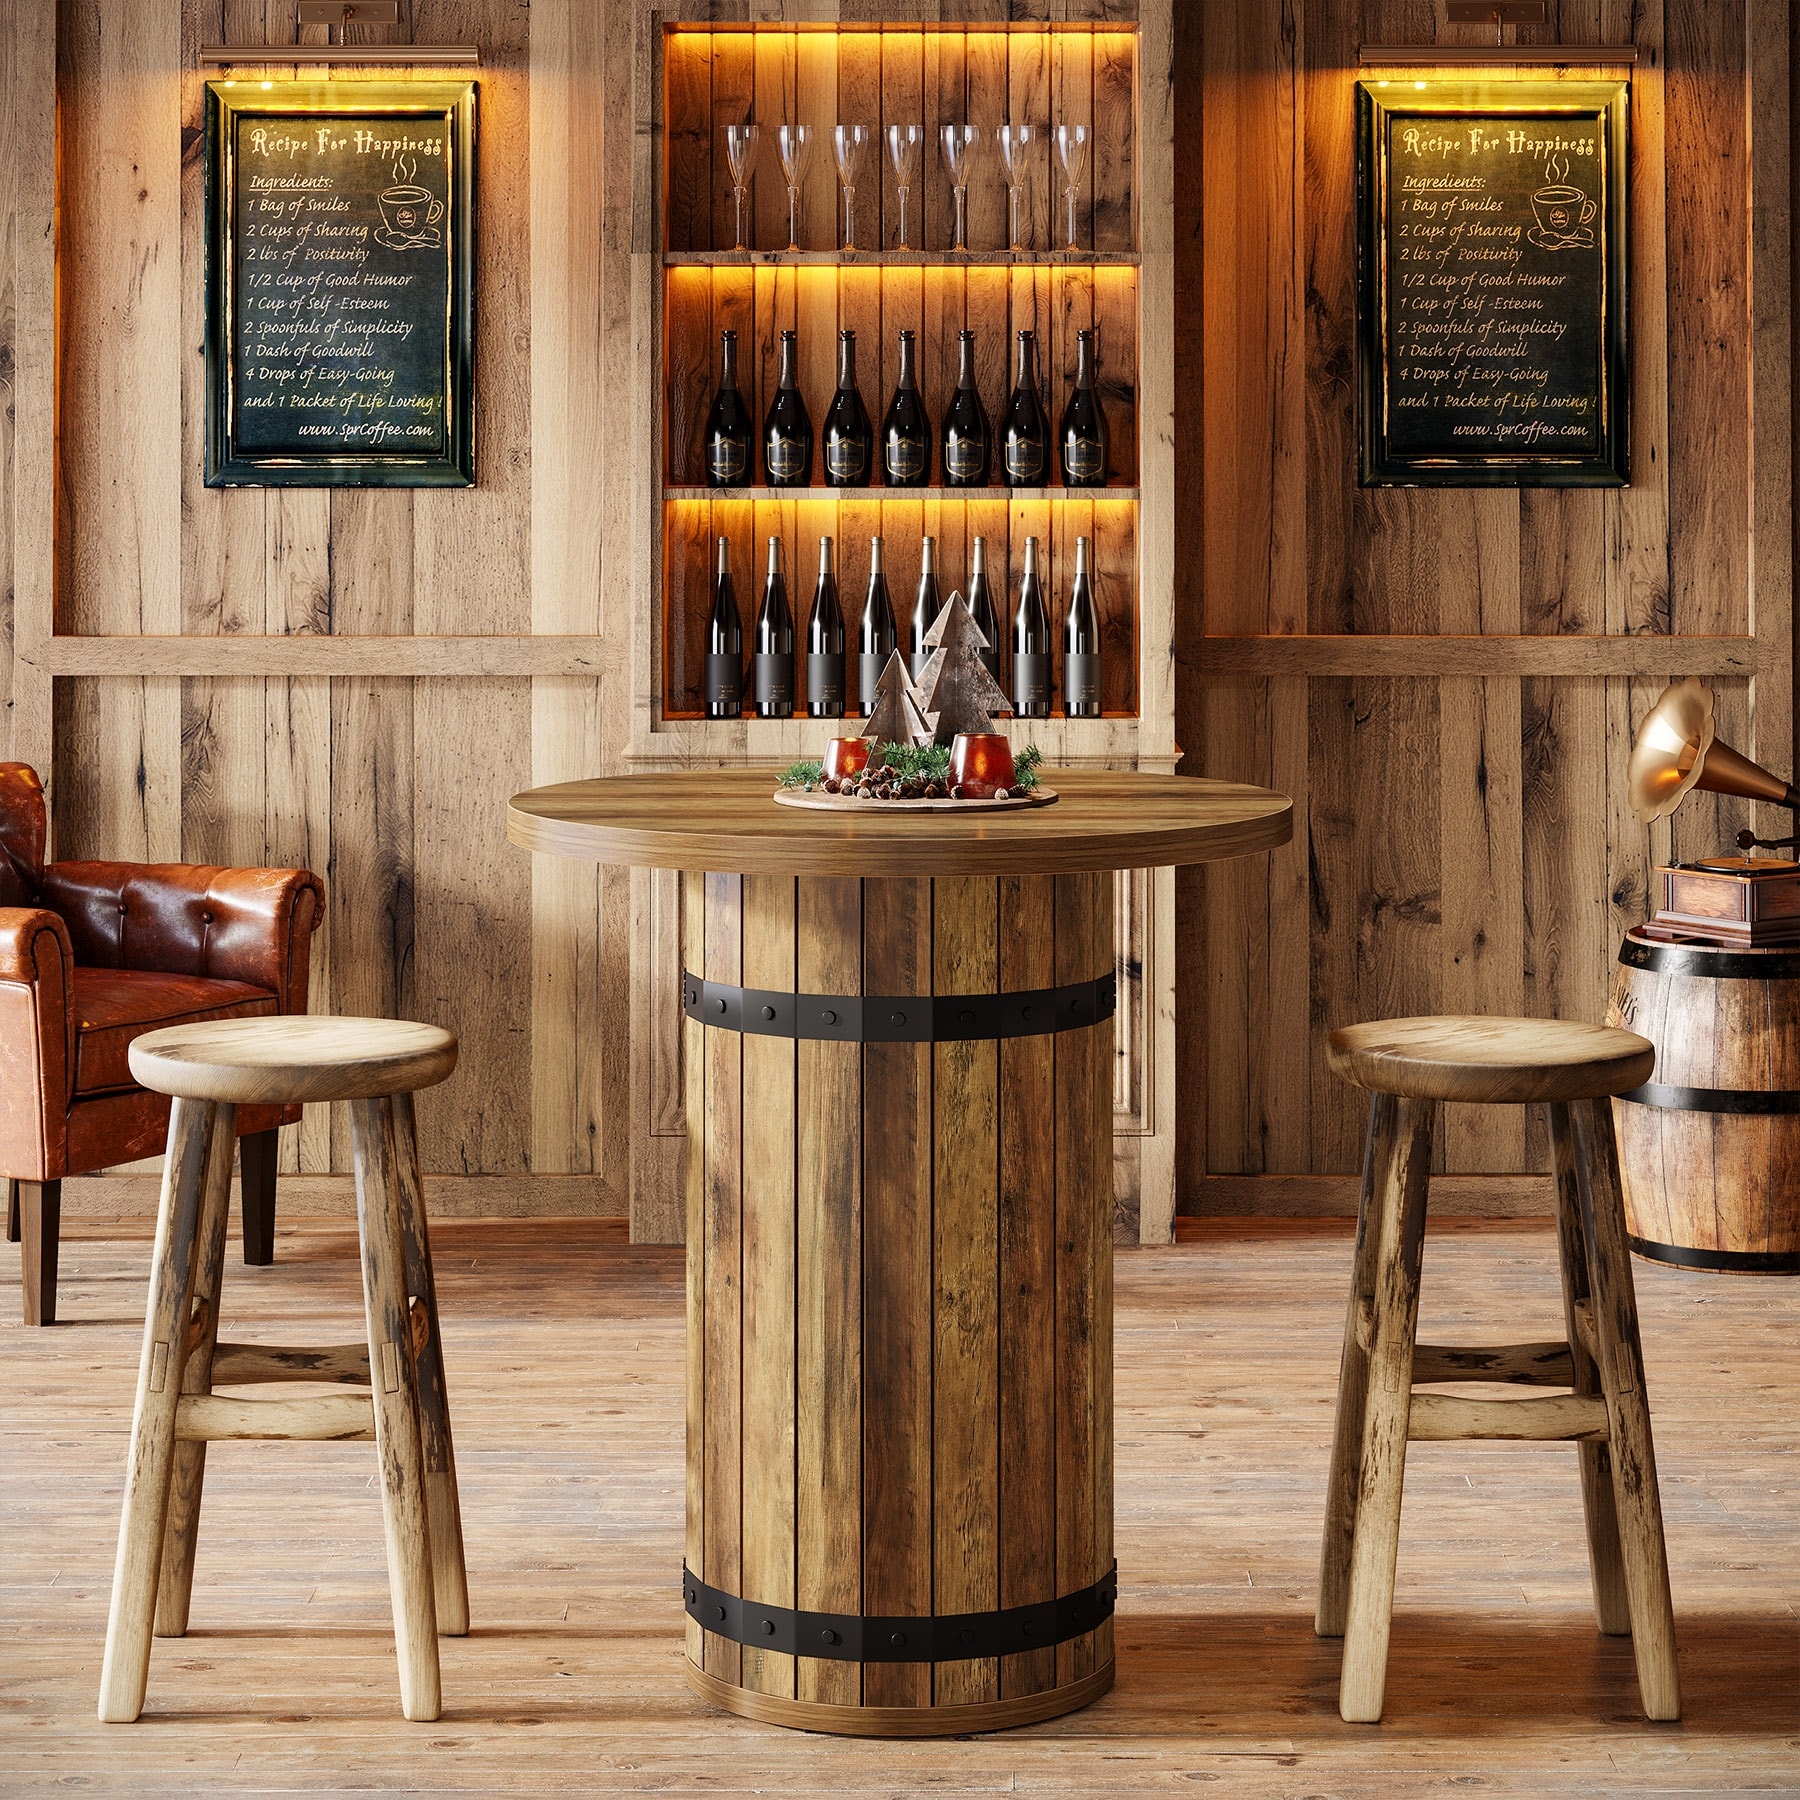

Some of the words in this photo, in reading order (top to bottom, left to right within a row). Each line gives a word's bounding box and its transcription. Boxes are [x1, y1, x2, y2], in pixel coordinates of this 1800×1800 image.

[250, 128, 308, 160] Recipe
[315, 127, 347, 155] For
[353, 130, 442, 160] Happiness
[1402, 128, 1461, 160] Recipe
[1467, 127, 1500, 155] For
[1505, 130, 1595, 160] Happiness
[250, 173, 333, 196] Ingredients:
[1402, 173, 1487, 196] Ingredients:
[248, 200, 255, 211] 1
[259, 199, 285, 219] Bag
[289, 196, 305, 220] of
[306, 196, 351, 212] Smiles
[1401, 200, 1408, 211] 1
[1412, 199, 1438, 219] Bag
[1441, 196, 1458, 220] of
[1460, 196, 1504, 212] Smiles
[246, 224, 255, 237] 2
[259, 224, 294, 243] Cups
[296, 221, 313, 245] of
[314, 221, 369, 244] Sharing
[1399, 224, 1409, 237] 2
[1412, 224, 1447, 243] Cups
[1449, 221, 1466, 245] of
[1467, 221, 1523, 244] Sharing
[246, 248, 256, 260] 2
[260, 245, 279, 261] lbs
[282, 245, 299, 269] of
[304, 247, 370, 268] Positivity
[1400, 248, 1410, 260] 2
[1413, 245, 1432, 261] lbs
[1435, 245, 1452, 269] of
[1457, 247, 1523, 268] Positivity
[248, 273, 272, 287] 1/2
[276, 273, 306, 292] Cup
[307, 271, 324, 294] of
[325, 271, 361, 287] Good
[363, 273, 413, 286] Humor
[1402, 273, 1426, 287] 1/2
[1429, 273, 1460, 292] Cup
[1460, 271, 1477, 295] of
[1478, 271, 1514, 287] Good
[1517, 273, 1567, 286] Humor
[247, 297, 254, 309] 1
[258, 297, 287, 315] Cup
[289, 295, 306, 318] of
[1401, 297, 1408, 309] 1
[1411, 297, 1440, 315] Cup
[1442, 295, 1459, 318] of
[243, 322, 253, 334] 2
[256, 319, 321, 341] Spoonfuls
[324, 319, 341, 342] of
[342, 319, 414, 341] Simplicity
[1397, 322, 1407, 334] 2
[1410, 319, 1474, 341] Spoonfuls
[1477, 319, 1495, 342] of
[1495, 319, 1568, 341] Simplicity
[244, 345, 251, 356] 1
[256, 342, 292, 357] Dash
[294, 342, 311, 366] of
[312, 342, 376, 359] Goodwill
[1398, 345, 1405, 356] 1
[1410, 342, 1446, 357] Dash
[1447, 342, 1465, 366] of
[1466, 342, 1529, 359] Goodwill
[245, 368, 255, 380] 4
[259, 367, 296, 387] Drops
[300, 365, 317, 388] of
[317, 367, 395, 388] Easy-Going
[1399, 368, 1409, 380] 4
[1413, 367, 1450, 387] Drops
[1453, 365, 1471, 388] of
[1471, 367, 1550, 388] Easy-Going
[243, 392, 275, 408] and
[279, 395, 286, 407] 1
[289, 392, 337, 408] Packet
[339, 393, 357, 416] of
[357, 392, 387, 415] Life
[1398, 392, 1430, 408] and
[1434, 395, 1440, 407] 1
[1444, 392, 1491, 408] Packet
[1493, 393, 1511, 416] of
[1511, 392, 1541, 415] Life
[298, 420, 435, 445] www.SprCoffee.com
[1452, 420, 1589, 445] www.SprCoffee.com
